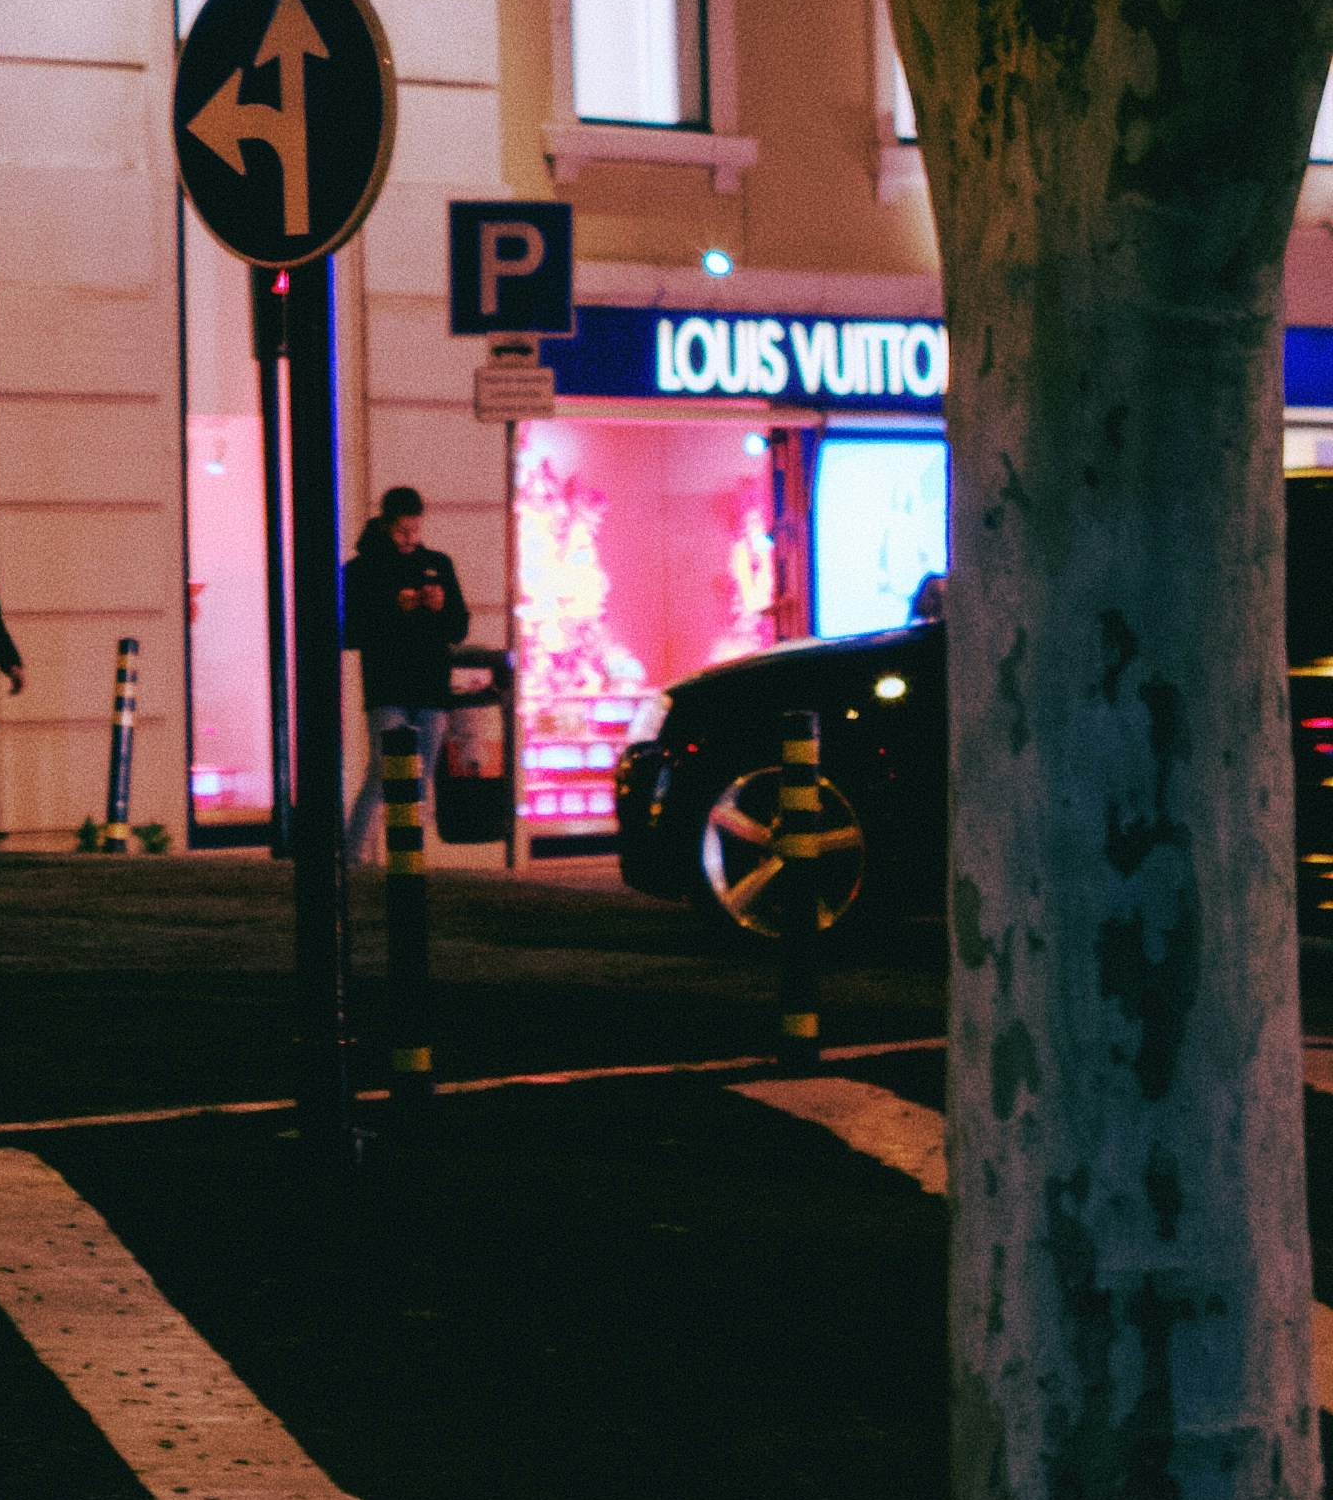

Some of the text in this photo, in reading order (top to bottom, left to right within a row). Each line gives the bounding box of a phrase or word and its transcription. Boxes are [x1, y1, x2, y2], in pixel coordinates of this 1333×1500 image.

[478, 221, 545, 316] P
[657, 317, 951, 397] LOUIS VUITTO
